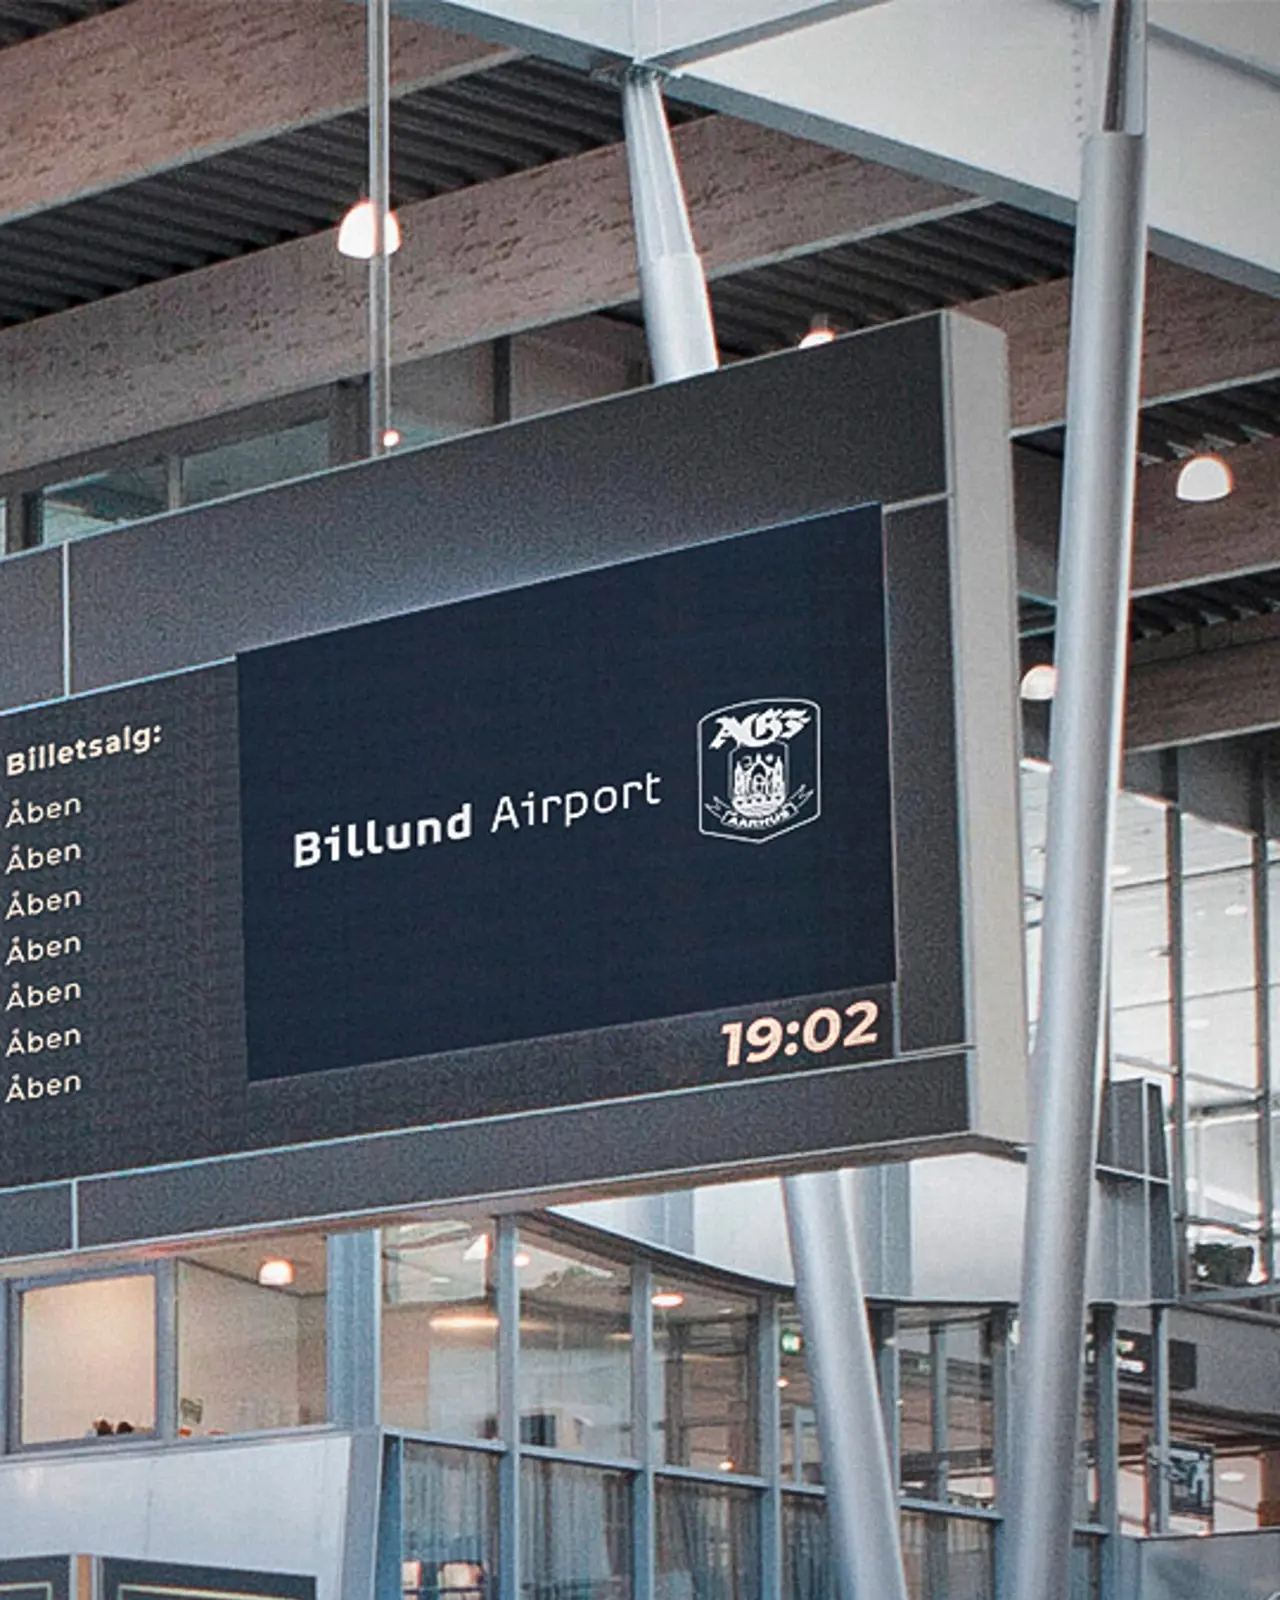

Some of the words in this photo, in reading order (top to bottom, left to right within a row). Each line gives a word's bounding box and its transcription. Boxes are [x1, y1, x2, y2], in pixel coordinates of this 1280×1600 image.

[6, 725, 162, 776] Billetsalg:
[5, 796, 81, 828] Åben
[293, 803, 472, 868] Billund
[491, 772, 662, 832] Airport
[5, 843, 81, 874] Åben
[5, 889, 81, 920] Åben
[5, 935, 81, 966] Åben
[5, 981, 81, 1011] Åben
[5, 1027, 81, 1057] Åben
[720, 1000, 879, 1067] 19:02
[5, 1073, 81, 1103] Åben
